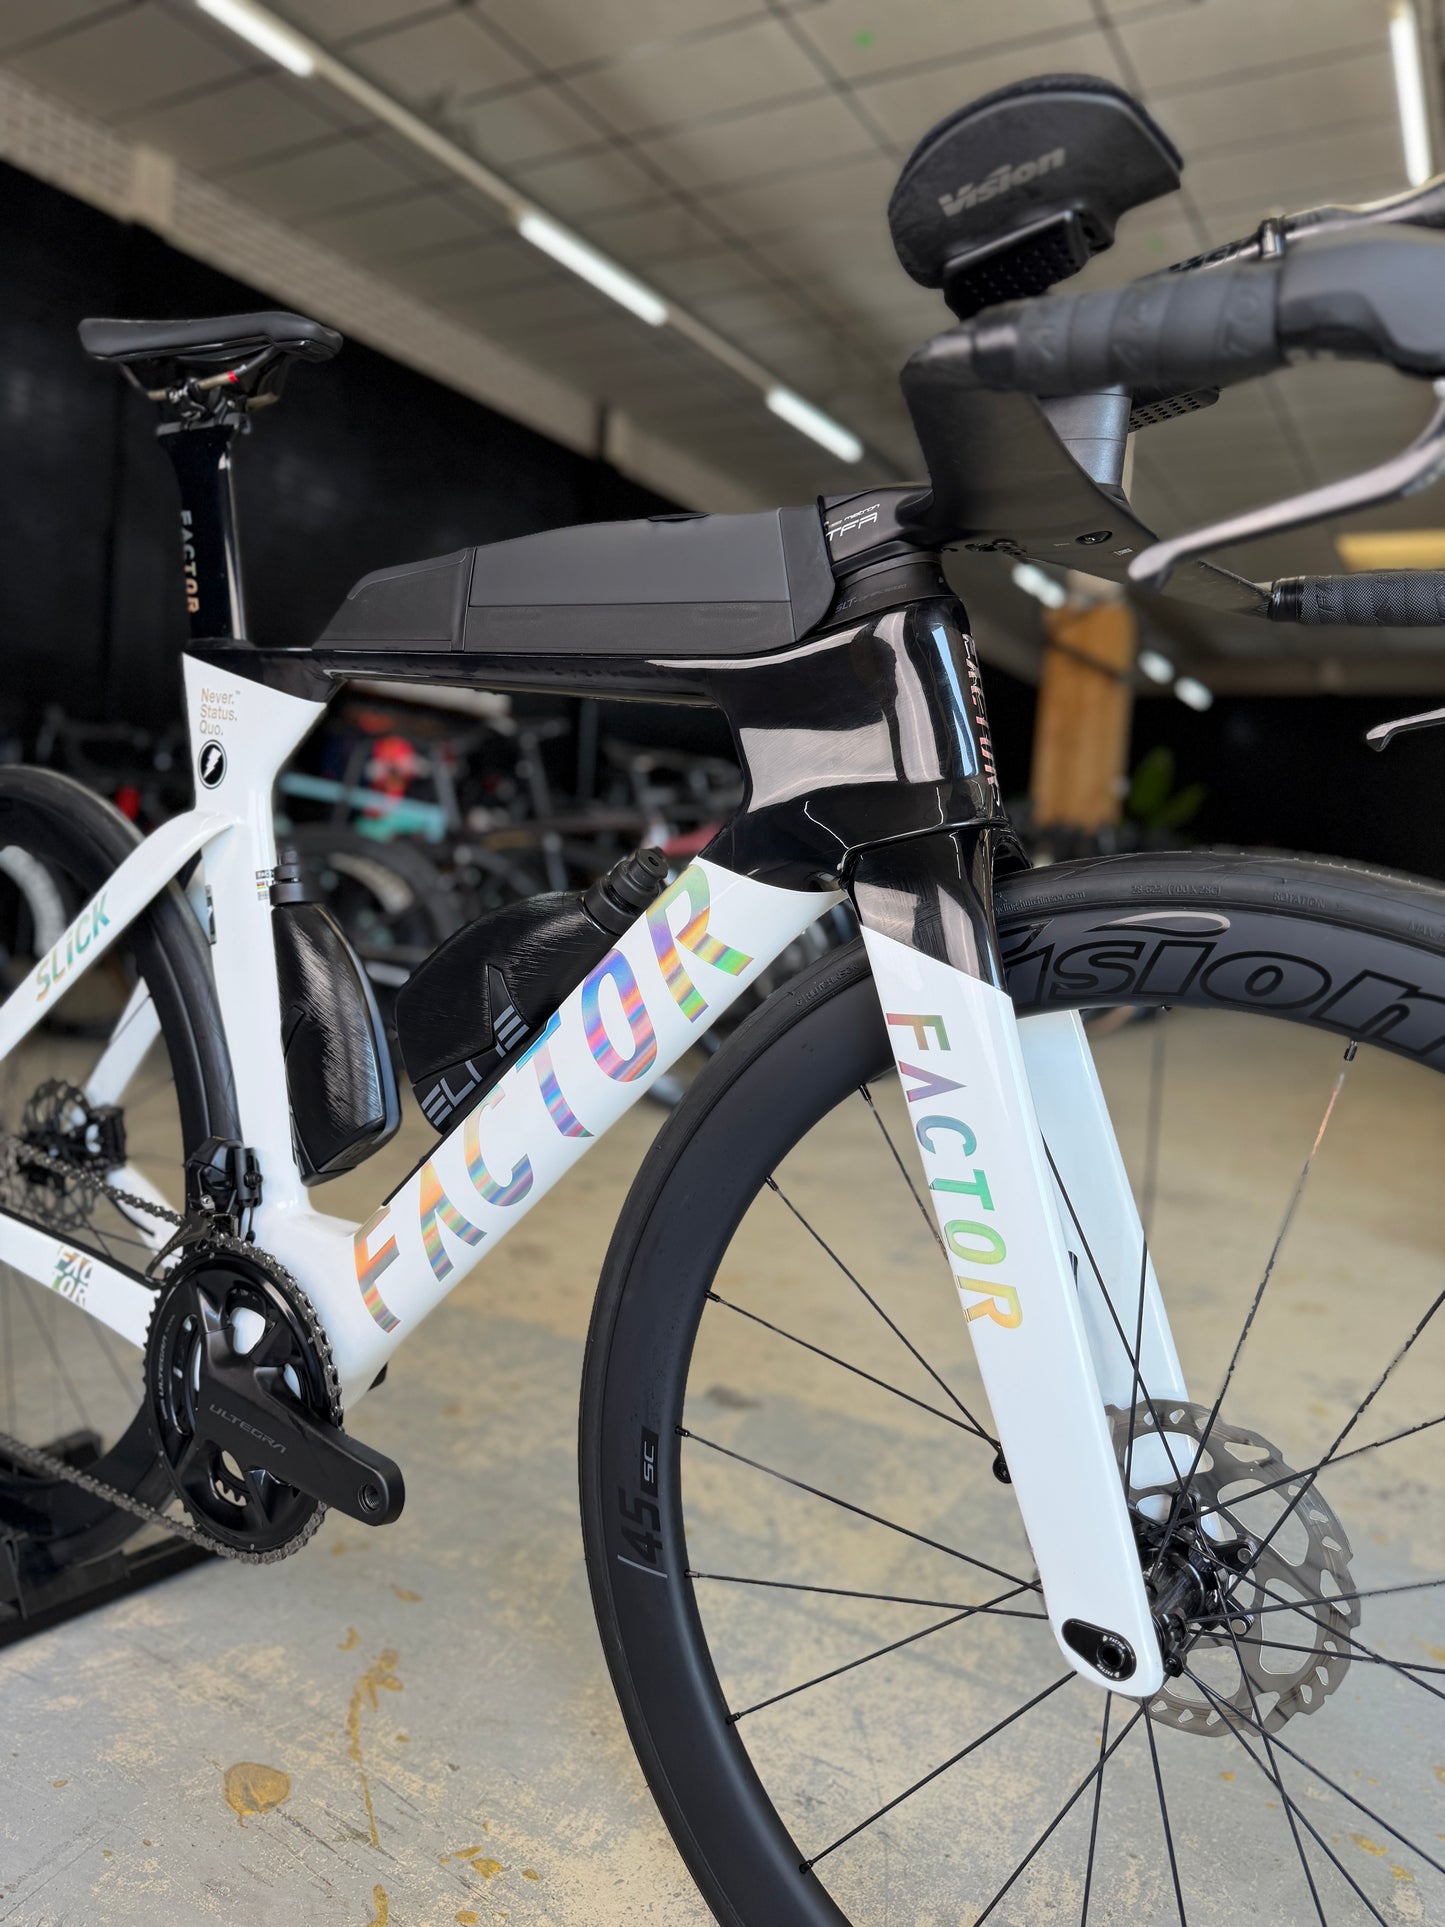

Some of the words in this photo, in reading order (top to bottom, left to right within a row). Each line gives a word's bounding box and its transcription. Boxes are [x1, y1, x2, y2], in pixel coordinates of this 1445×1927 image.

[938, 147, 1065, 217] Vision
[181, 509, 200, 613] FACTOR
[199, 719, 223, 736] Quo.
[200, 703, 237, 721] Status.
[201, 687, 234, 704] Never.
[999, 911, 1445, 1056] ision
[354, 864, 754, 1333] FACTOR
[885, 1012, 1022, 1330] FACTOR
[209, 1404, 287, 1454] ULTEGRA
